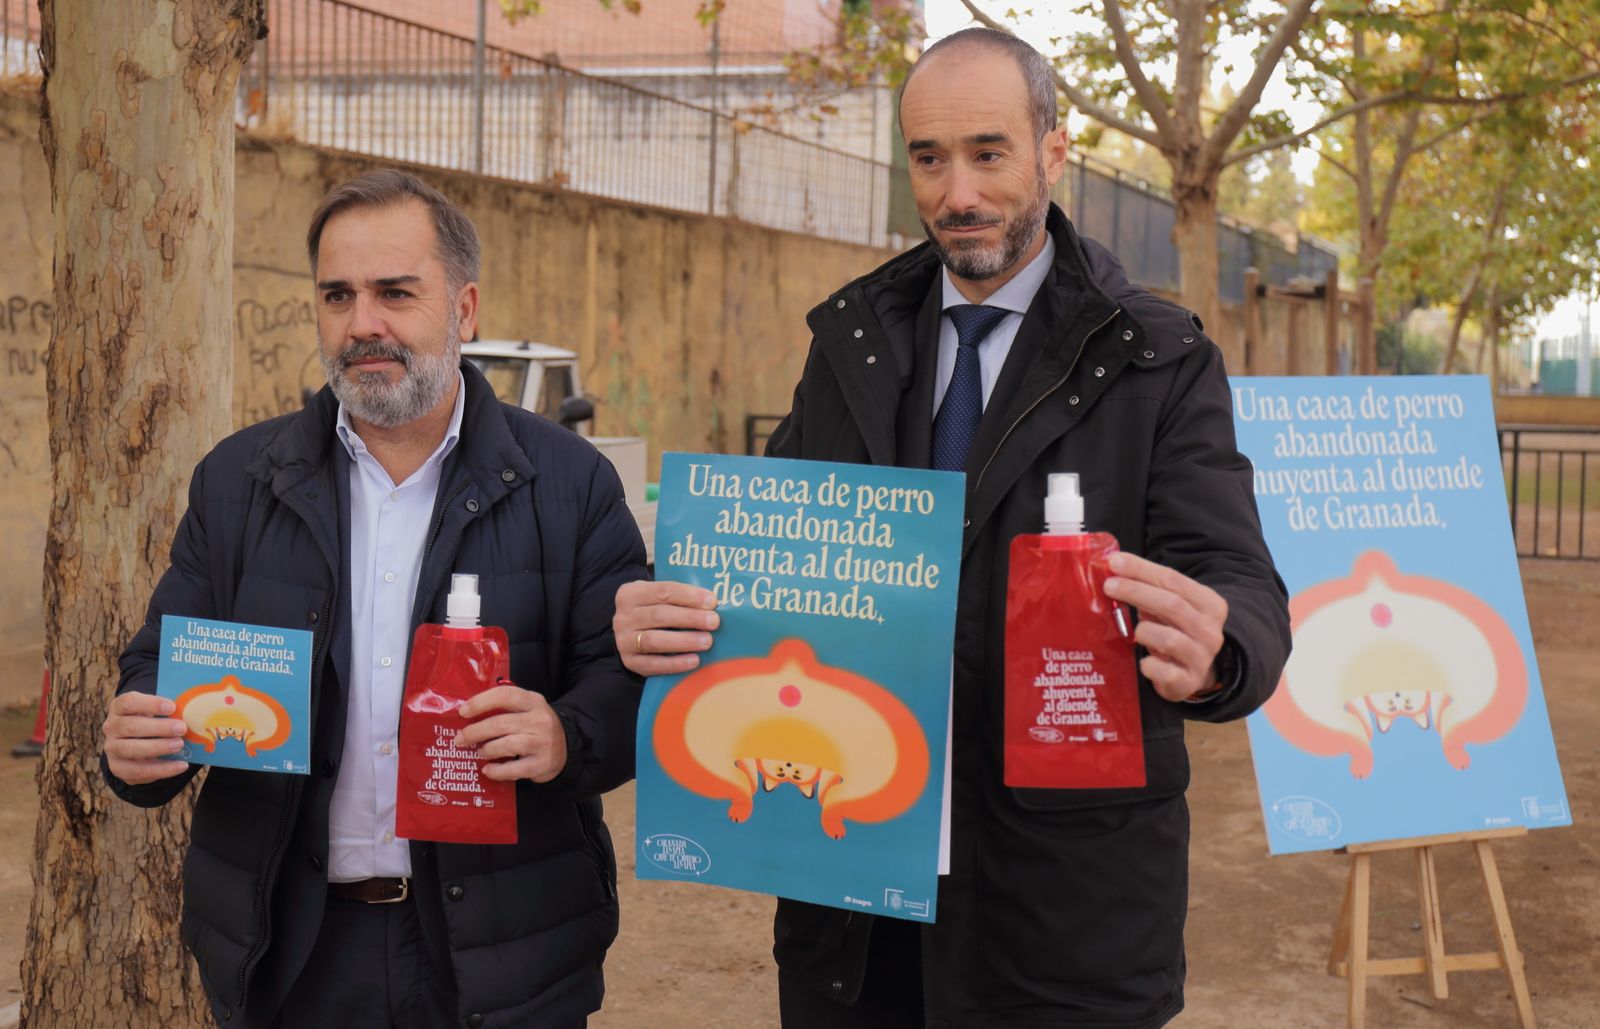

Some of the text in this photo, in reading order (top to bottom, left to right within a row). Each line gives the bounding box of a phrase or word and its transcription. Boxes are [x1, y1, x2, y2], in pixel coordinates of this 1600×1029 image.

[1234, 384, 1464, 428] Una caca de perro
[1274, 422, 1436, 458] abandonada
[1253, 456, 1483, 503] huyenta al duende
[688, 463, 934, 518] Una caca de perro
[1288, 496, 1320, 532] de
[715, 502, 894, 548] abandonada
[668, 533, 940, 589] ahuyenta al duende
[713, 572, 745, 608] de
[187, 622, 284, 646] Una caca de perro
[172, 635, 295, 661] abandonada ahuyenta
[1042, 648, 1094, 660] Una caca
[172, 650, 294, 675] al duende de Granada.
[1045, 660, 1092, 676] de perro
[1034, 672, 1105, 687] abandonada
[1042, 686, 1096, 700] ahuyenta
[1044, 698, 1098, 712] al duende
[1036, 712, 1051, 725] de
[434, 725, 455, 737] Una
[436, 736, 448, 747] de
[426, 746, 484, 760] abandonad
[432, 758, 478, 771] ahuyenta
[432, 769, 479, 780] al duende
[425, 778, 438, 790] de
